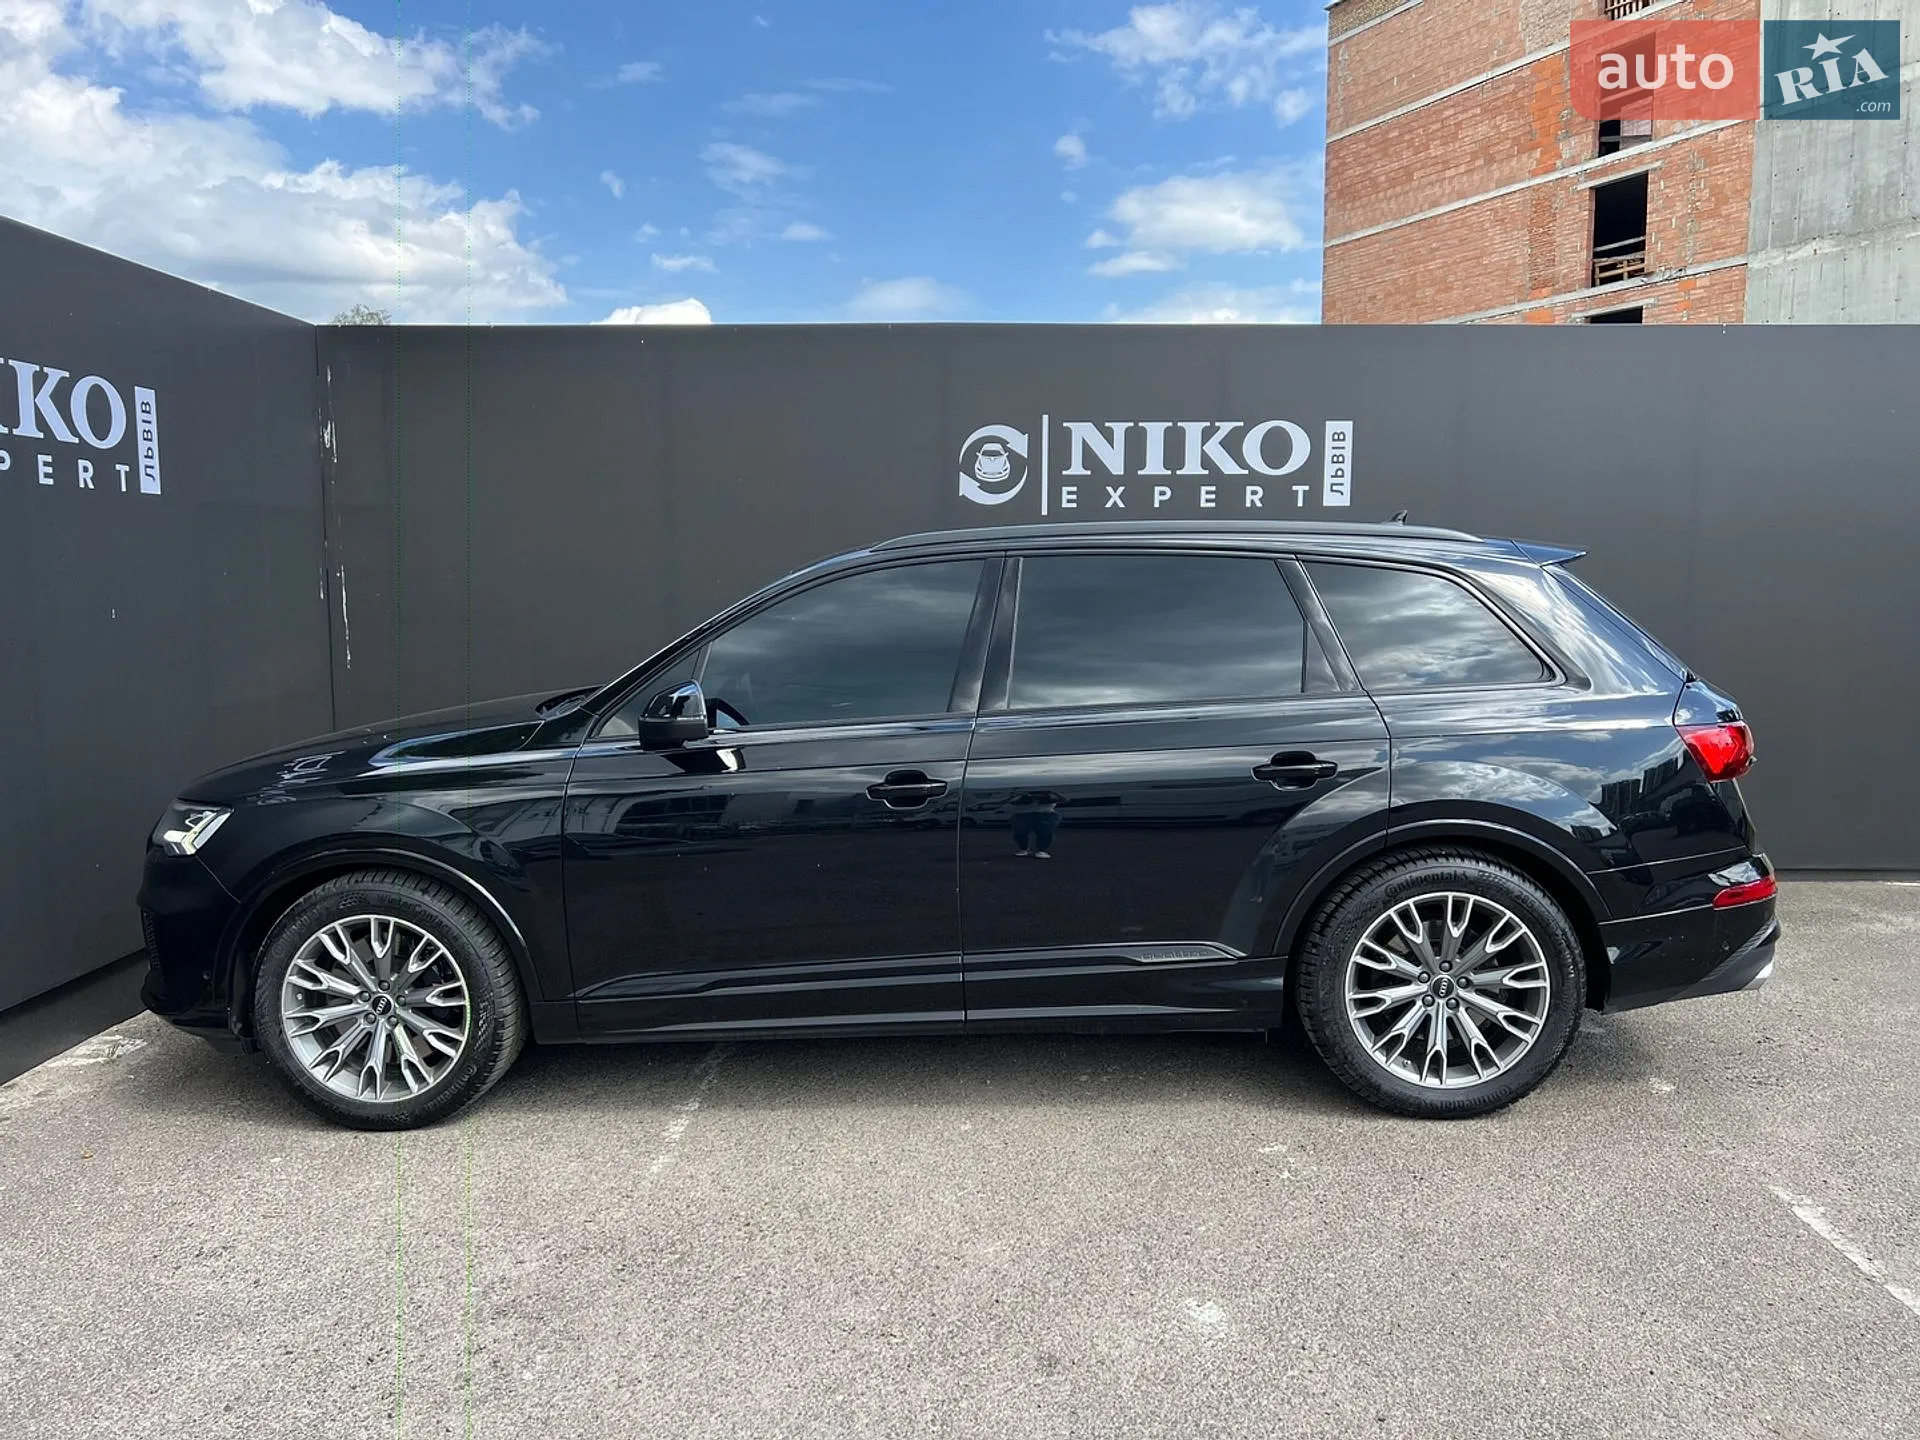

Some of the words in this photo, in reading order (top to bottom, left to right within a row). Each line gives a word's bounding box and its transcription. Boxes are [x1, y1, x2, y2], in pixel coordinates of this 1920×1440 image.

[141, 400, 156, 481] ЛЬВІВ
[1062, 420, 1311, 475] NIKO
[1330, 431, 1346, 496] ЛЬВІВ
[1061, 486, 1310, 508] EXPERT
